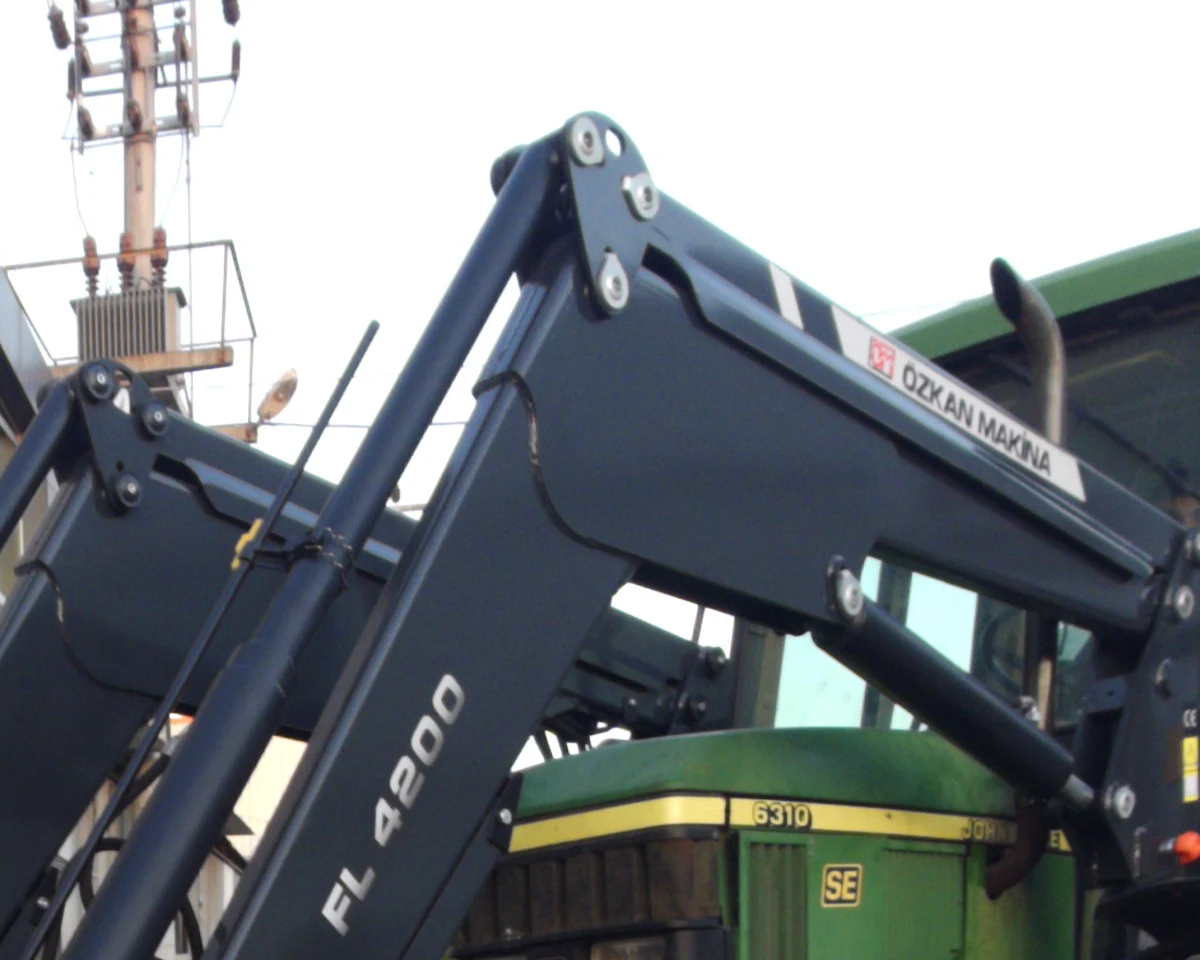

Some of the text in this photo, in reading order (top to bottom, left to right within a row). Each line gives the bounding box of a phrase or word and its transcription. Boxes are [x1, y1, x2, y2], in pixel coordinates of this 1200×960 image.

[902, 362, 974, 428] ÖZKAN
[321, 673, 465, 937] FL 4200
[753, 802, 811, 828] 6310
[825, 870, 858, 901] SE
